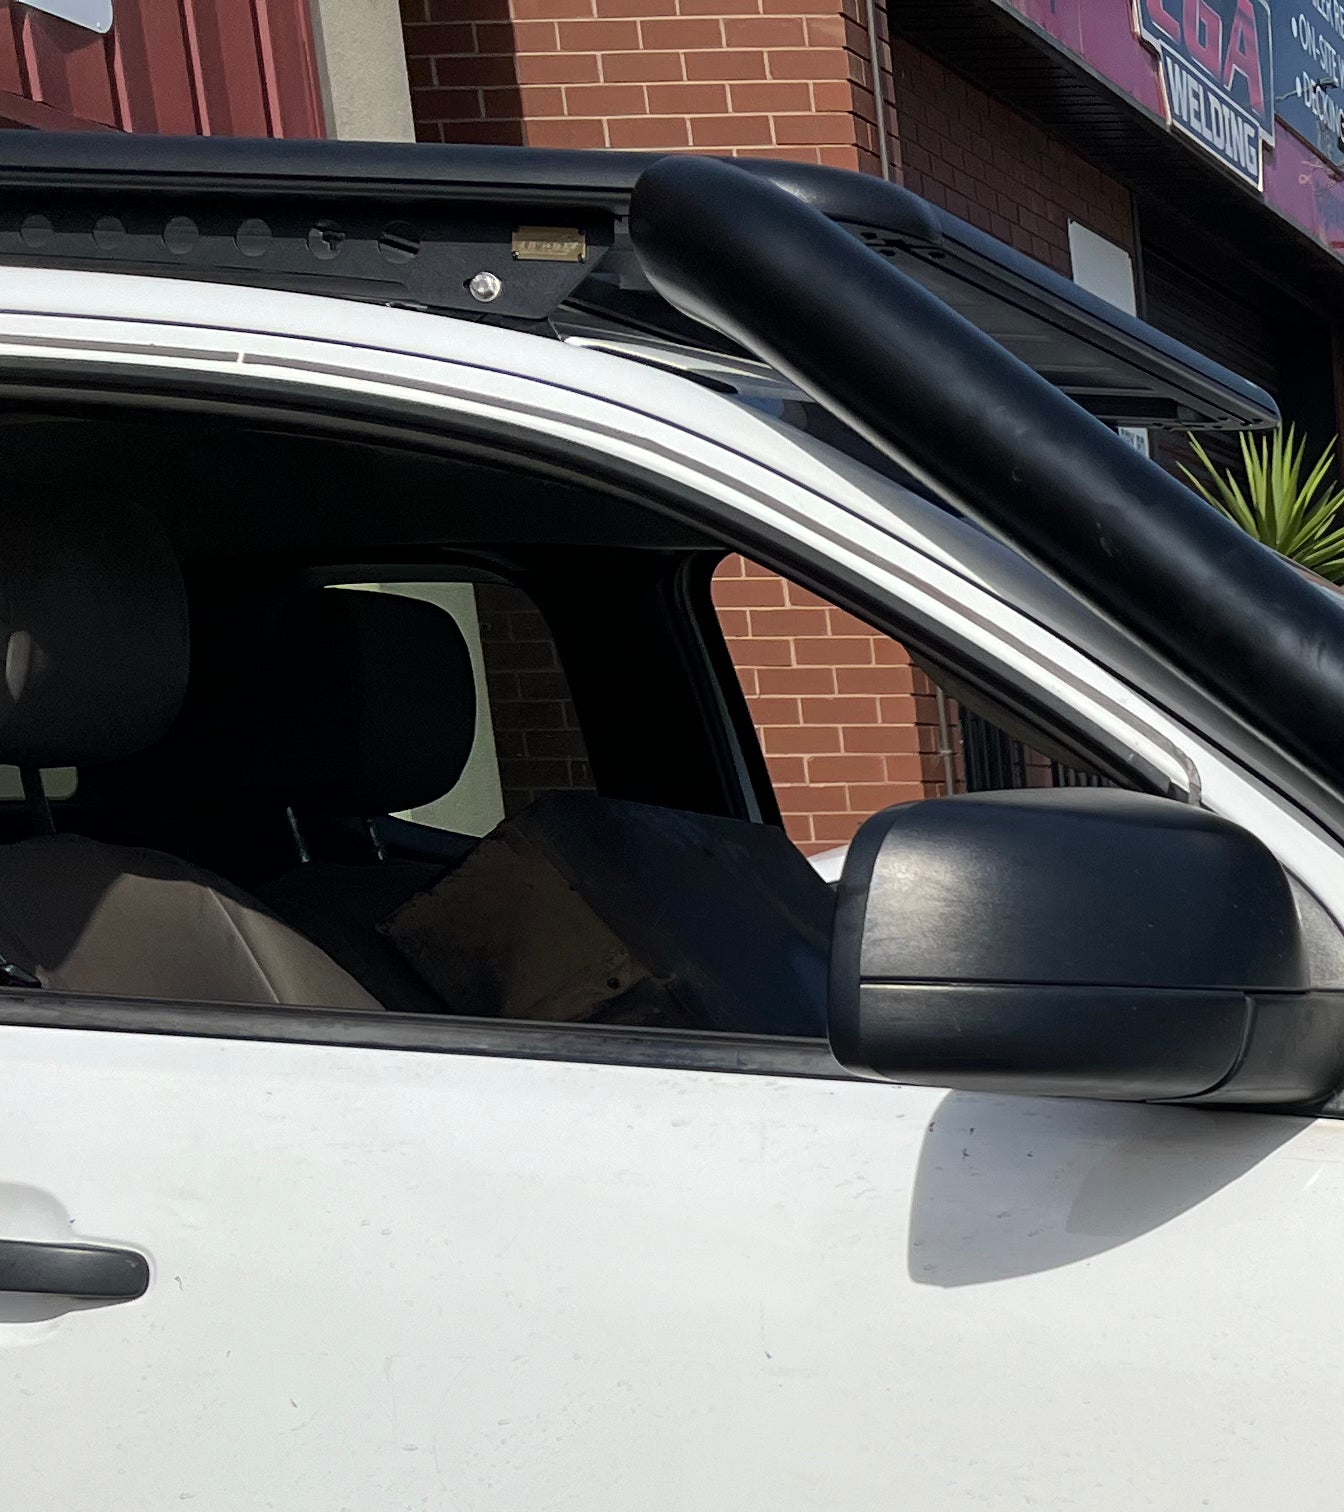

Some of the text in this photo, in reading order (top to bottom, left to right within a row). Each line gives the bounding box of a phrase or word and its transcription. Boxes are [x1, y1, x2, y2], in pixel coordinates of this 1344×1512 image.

[1147, 0, 1265, 117] GA
[1299, 13, 1339, 85] ON-SITE
[1165, 55, 1259, 177] WELDING
